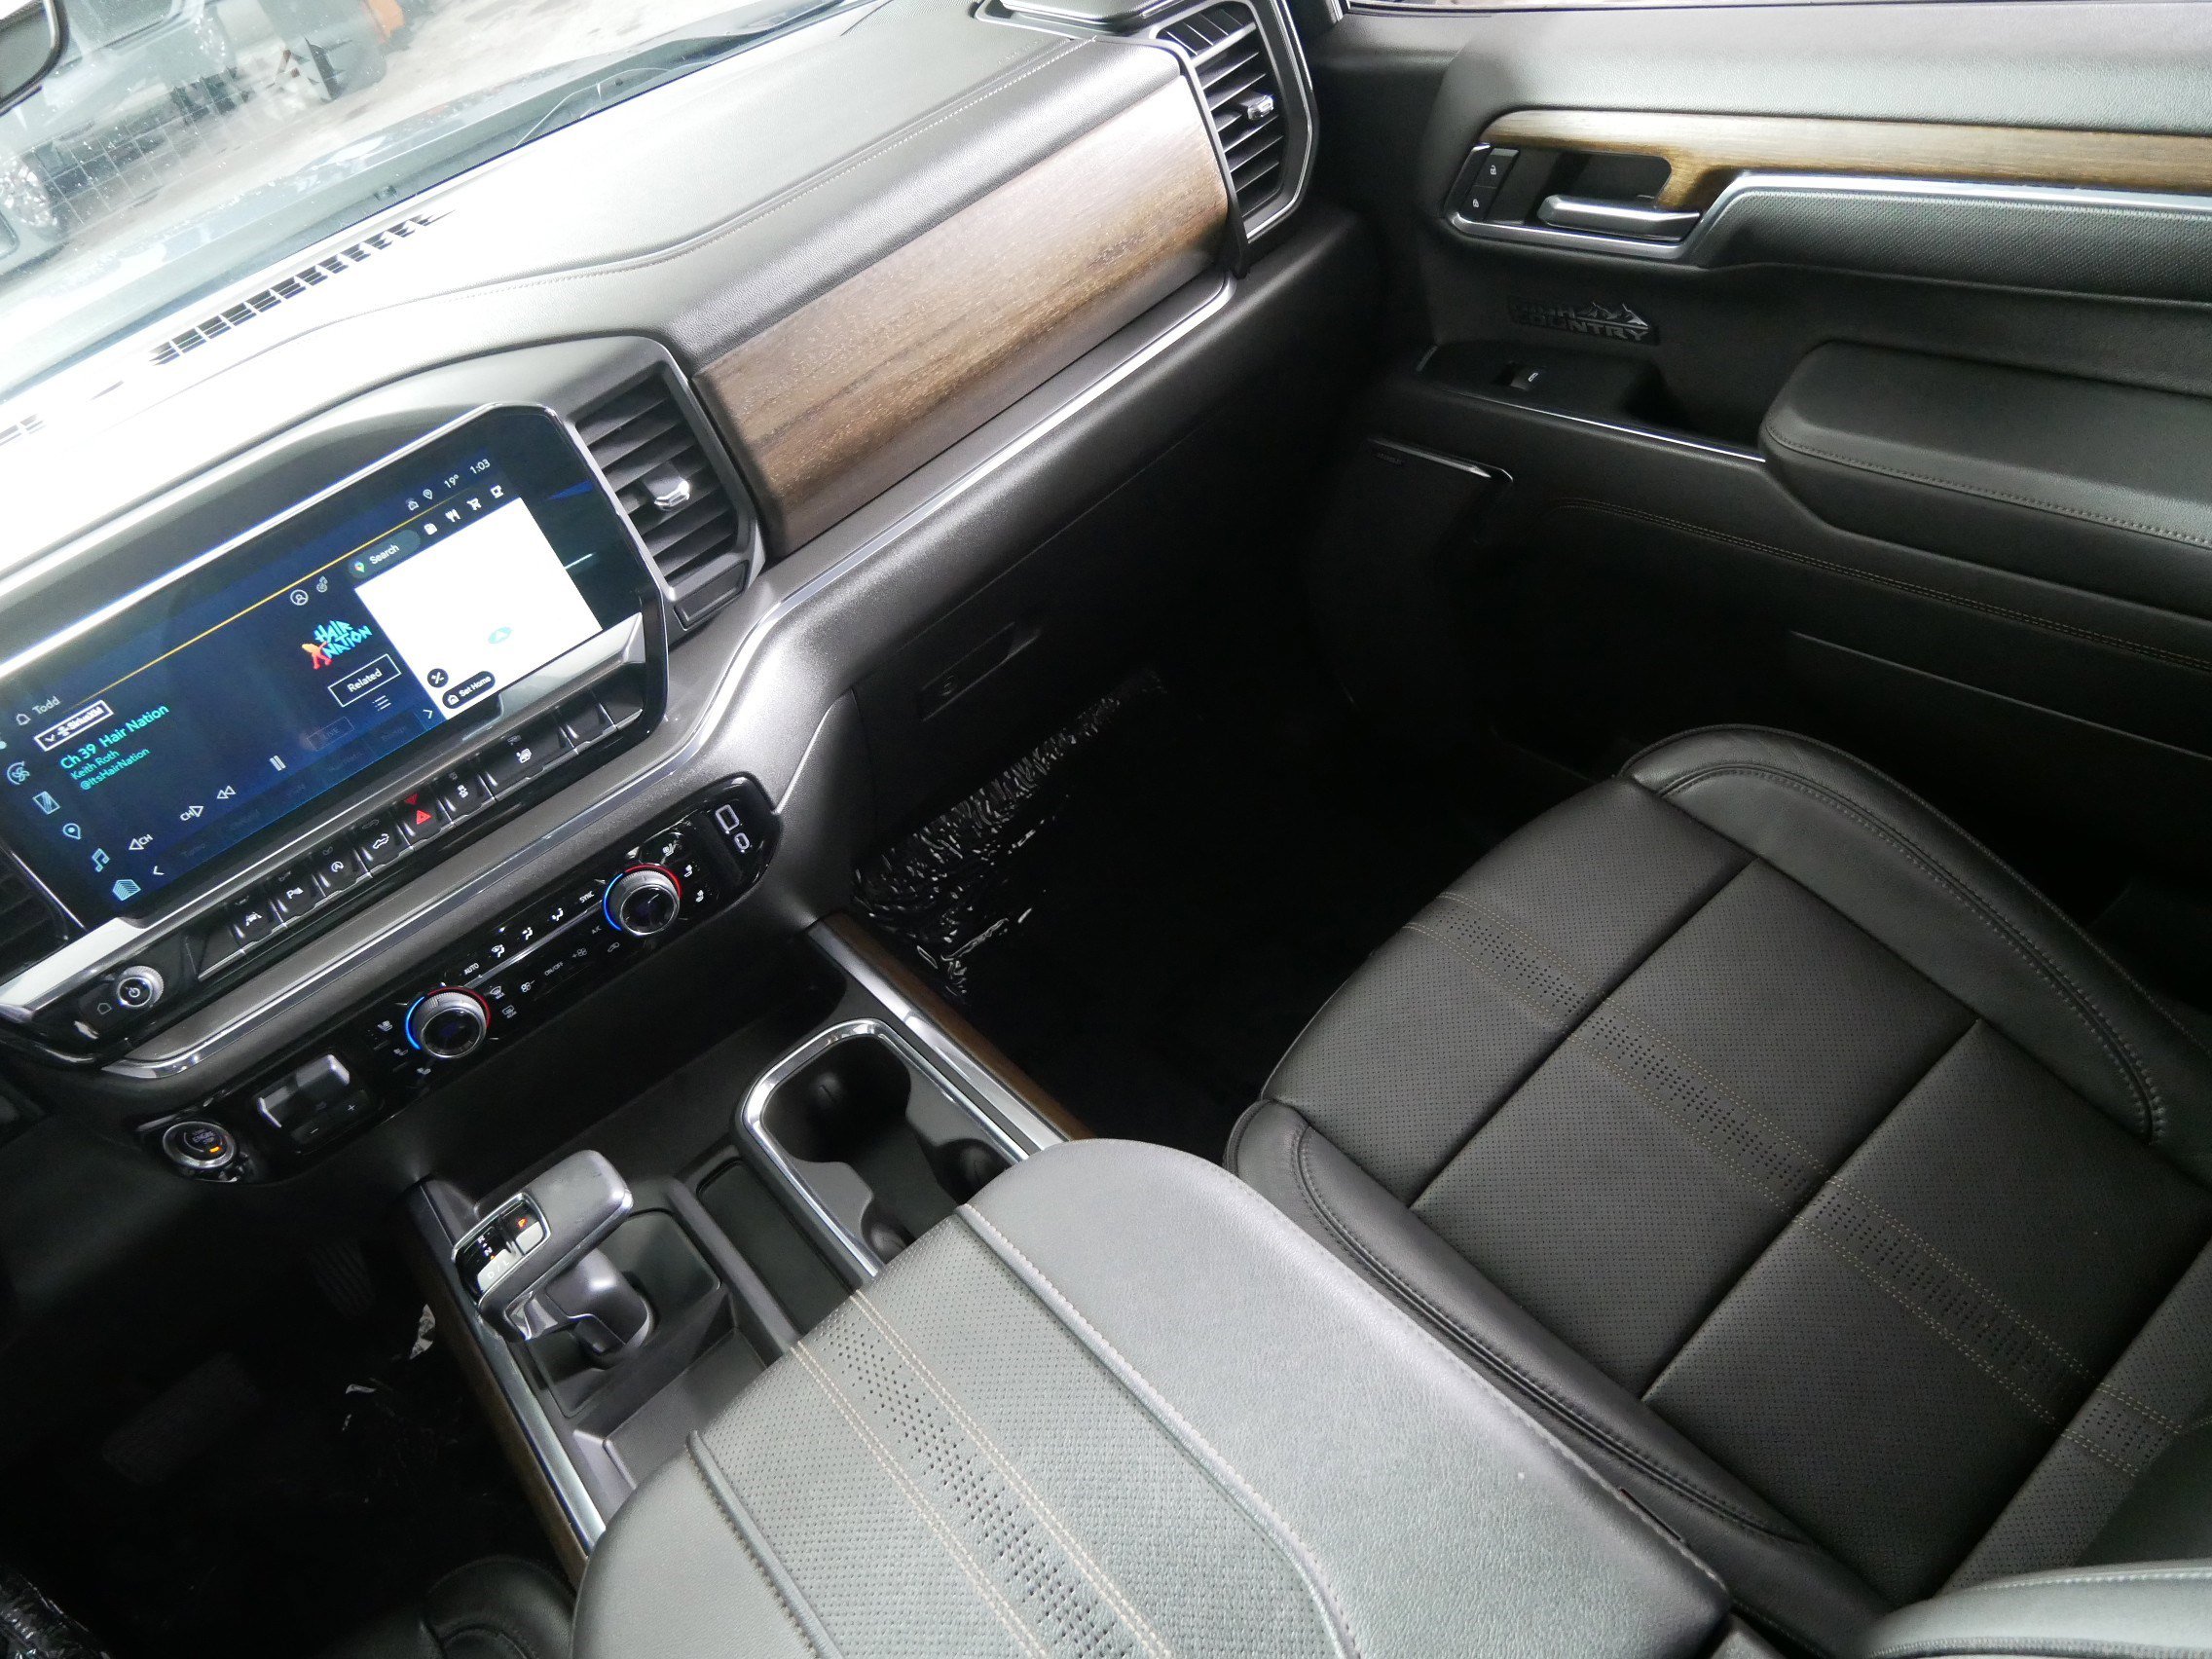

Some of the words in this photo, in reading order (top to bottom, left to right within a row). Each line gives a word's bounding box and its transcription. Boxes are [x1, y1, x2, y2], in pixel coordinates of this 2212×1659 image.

[469, 459, 491, 474] 1:03
[369, 543, 400, 565] Search
[313, 619, 353, 643] HAIR
[322, 625, 373, 659] NATION
[347, 668, 383, 692] Related
[459, 685, 472, 697] Set
[471, 676, 492, 689] Home
[32, 696, 61, 715] Todd
[59, 753, 82, 769] Ch
[77, 743, 97, 760] 39
[98, 727, 128, 748] Hair
[126, 705, 170, 733] Nation
[70, 762, 98, 780] Keith
[94, 749, 121, 767] Roth
[80, 748, 152, 791] @ItsHairNation
[578, 890, 595, 903] SYNC
[463, 962, 480, 976] AUTO
[544, 961, 564, 977] ON/OFF
